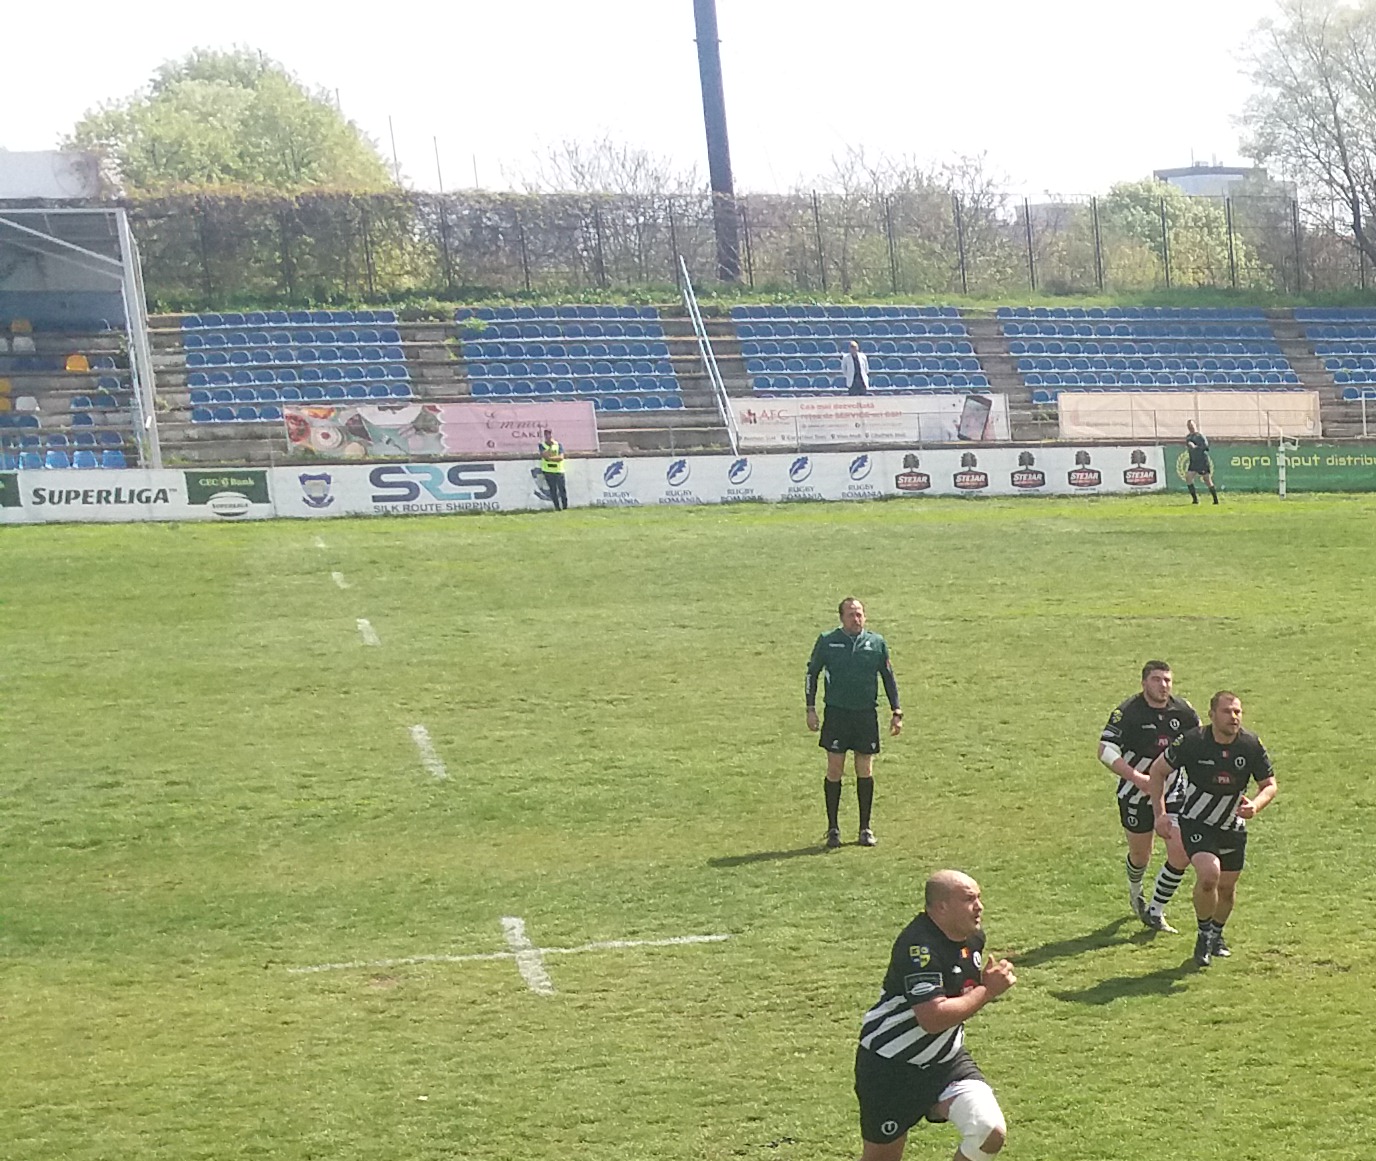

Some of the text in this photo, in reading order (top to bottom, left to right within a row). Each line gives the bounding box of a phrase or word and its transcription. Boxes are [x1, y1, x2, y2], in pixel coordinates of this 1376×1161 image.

[1231, 454, 1271, 469] agro
[898, 475, 928, 484] STEJAR
[956, 474, 985, 483] STEJAR
[1013, 473, 1043, 481] STEJAR
[1070, 472, 1099, 480] STEJAR
[1126, 471, 1154, 479] STEJAR
[369, 463, 498, 501] SRS
[32, 486, 169, 506] SUPERLIGA
[374, 501, 499, 513] SILK ROUTE SHIPPING
